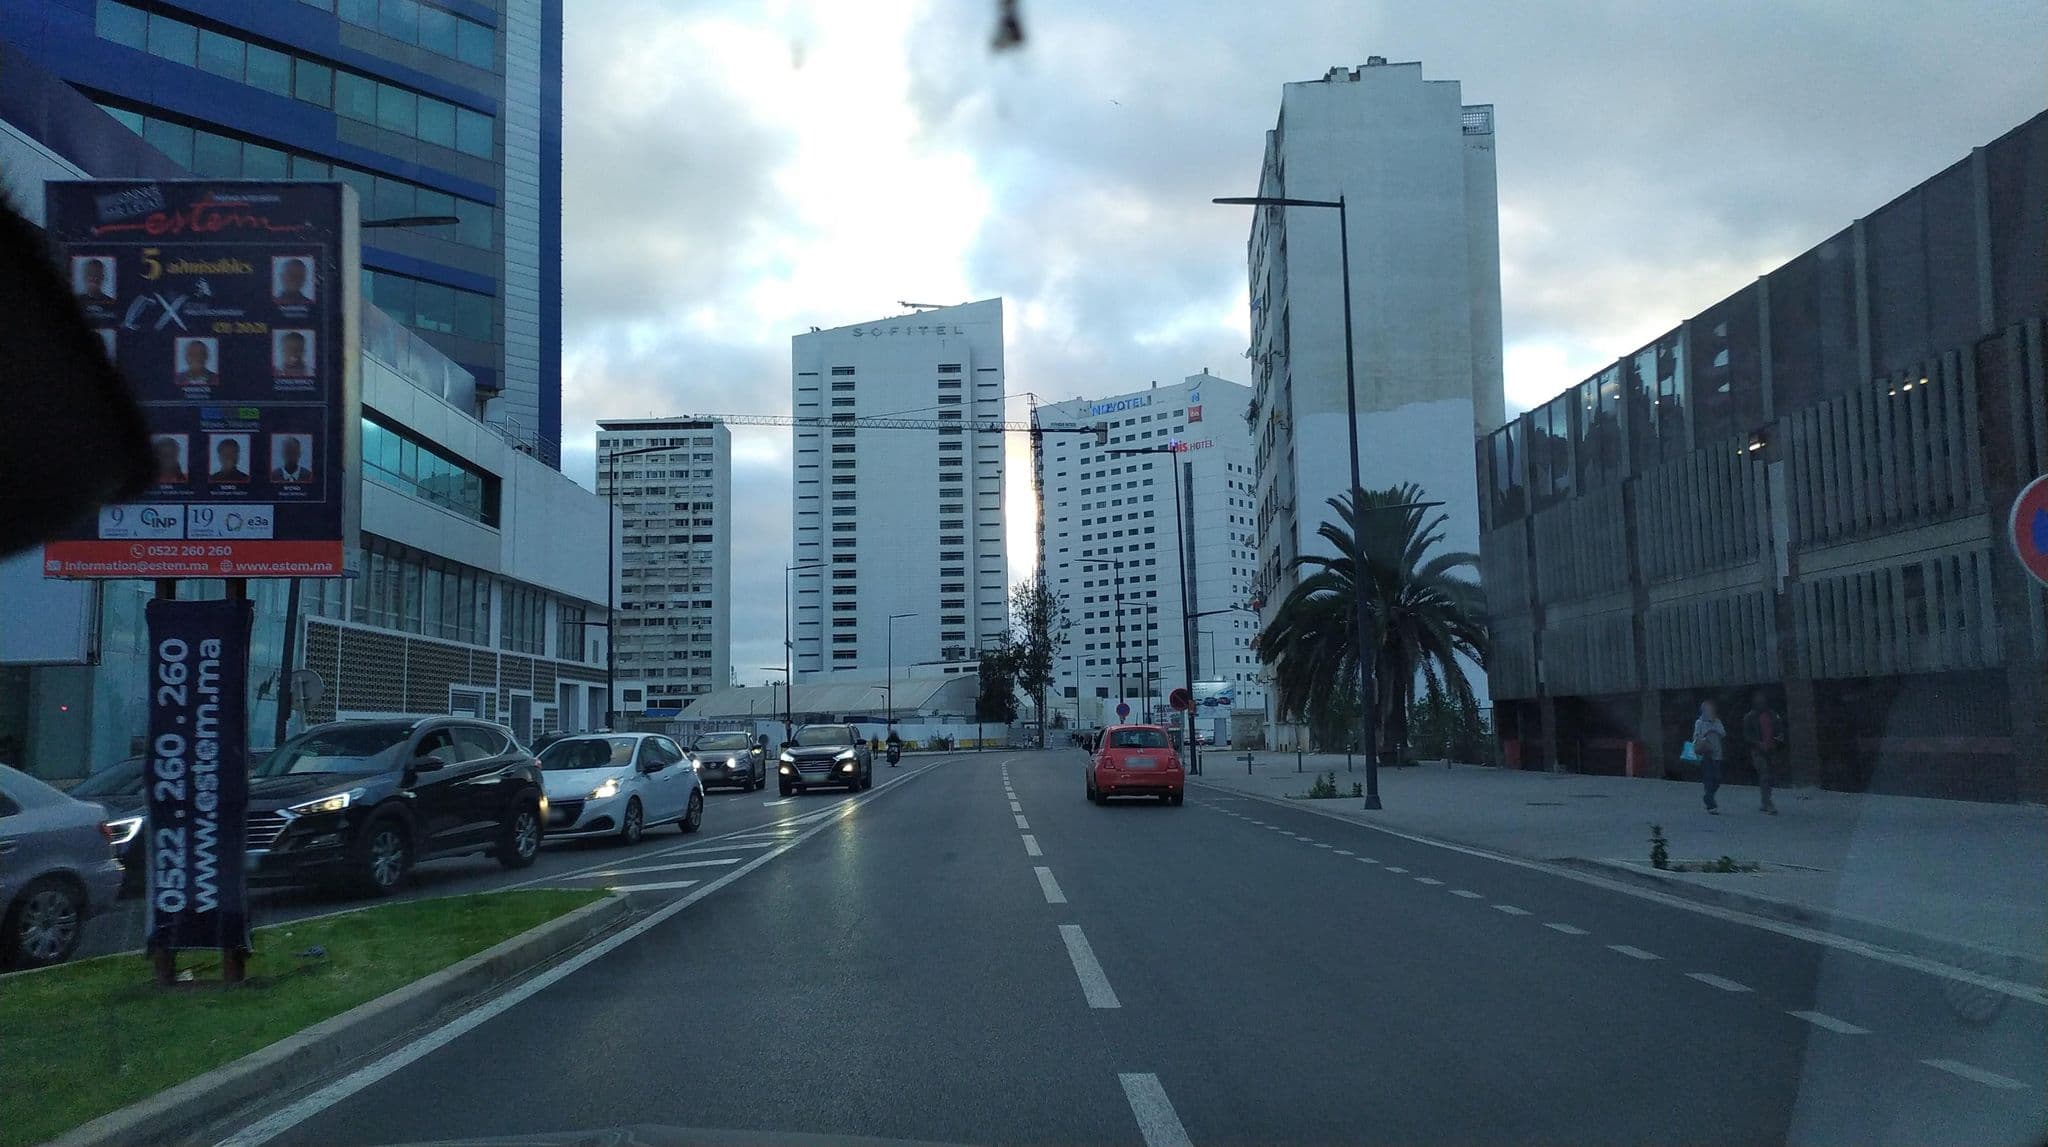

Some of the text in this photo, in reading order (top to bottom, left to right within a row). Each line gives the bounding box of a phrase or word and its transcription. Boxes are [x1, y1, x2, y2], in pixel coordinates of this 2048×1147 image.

[136, 248, 162, 281] 5
[852, 326, 964, 337] SOFITEL
[1089, 397, 1146, 417] NOVOTEL
[1190, 439, 1215, 451] HOTEL
[111, 507, 124, 526] 9
[192, 507, 214, 527] 19
[247, 516, 269, 527] e3a
[148, 545, 232, 557] 0522 260 260
[236, 560, 333, 572] www.estem.ma
[157, 637, 189, 707] 260
[191, 638, 222, 914] www.estem.ma
